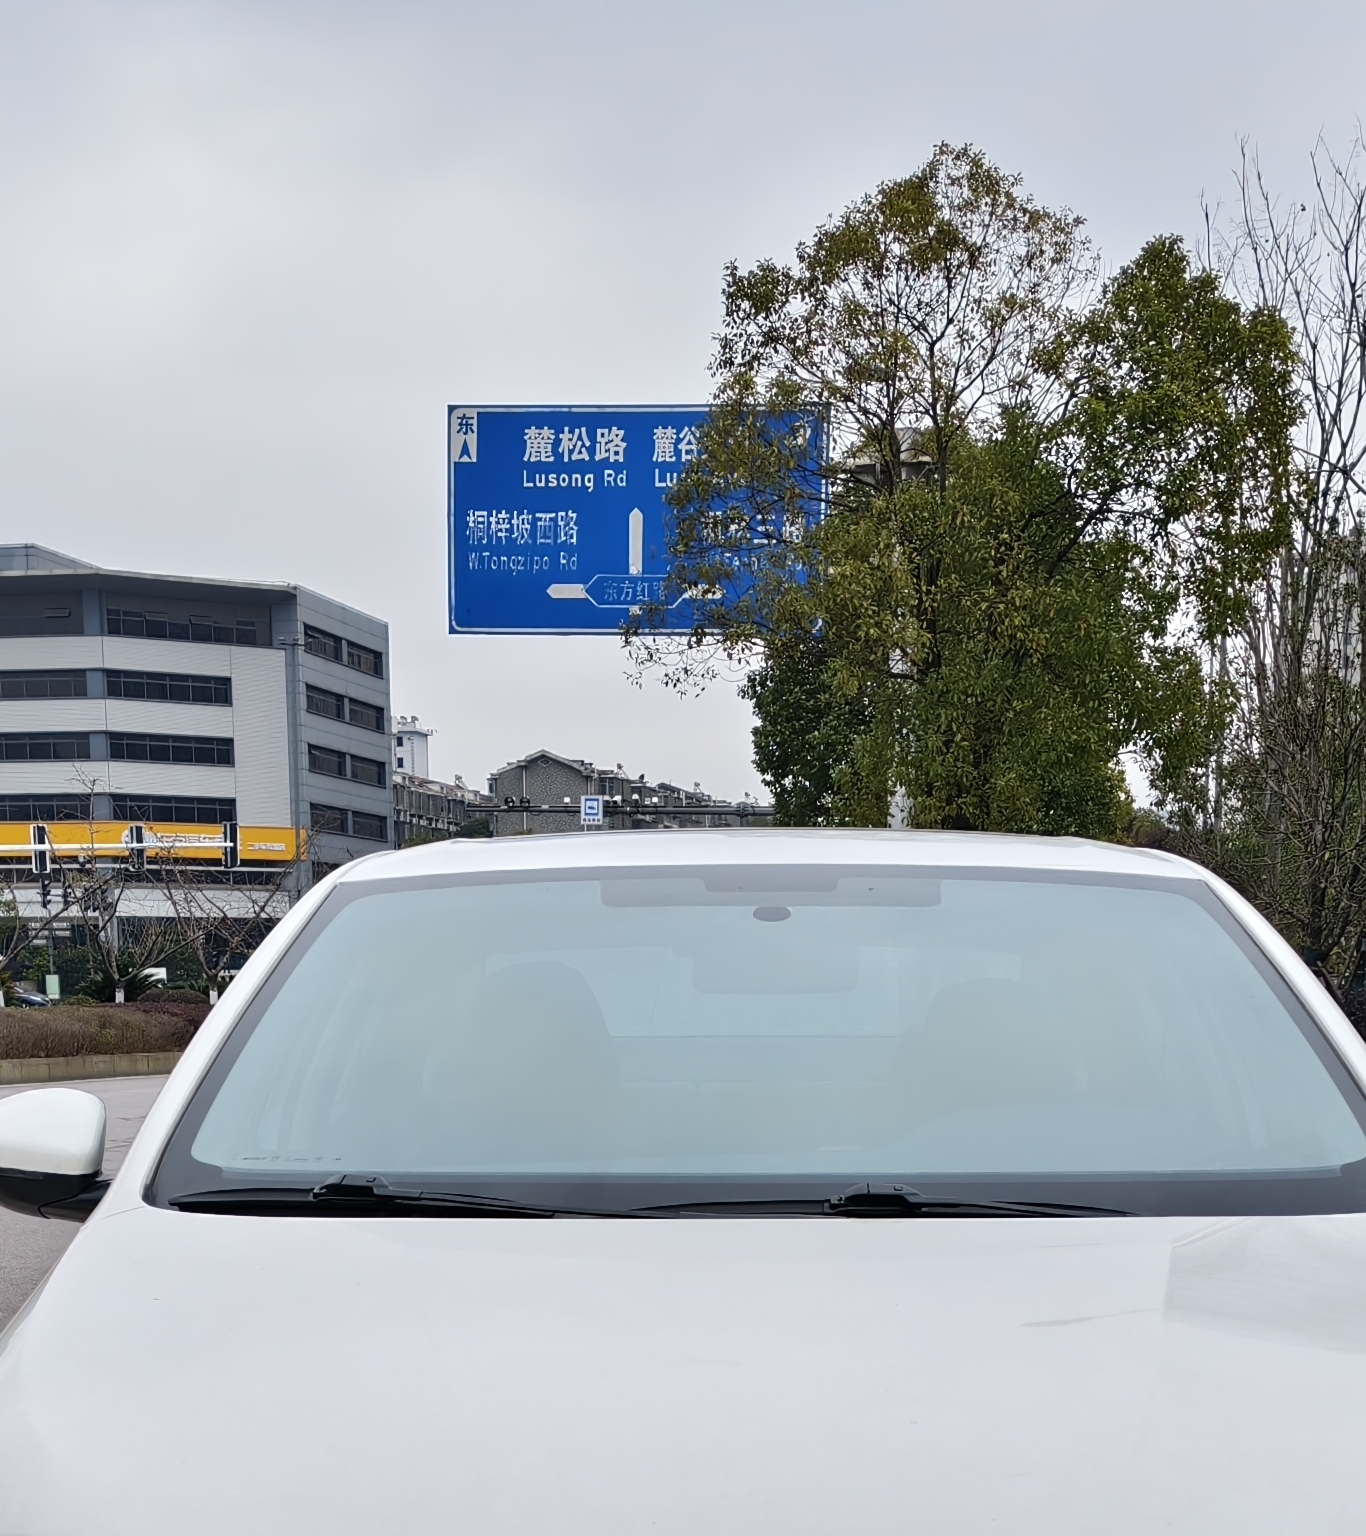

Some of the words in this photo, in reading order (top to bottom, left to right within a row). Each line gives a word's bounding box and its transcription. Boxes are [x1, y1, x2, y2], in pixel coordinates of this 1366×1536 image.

[456, 413, 476, 436] 东
[523, 427, 628, 463] 麓松路
[523, 470, 595, 493] Lusong
[604, 470, 627, 488] Rd
[466, 509, 579, 546] 桐梓坡西路
[560, 552, 578, 571] Rd
